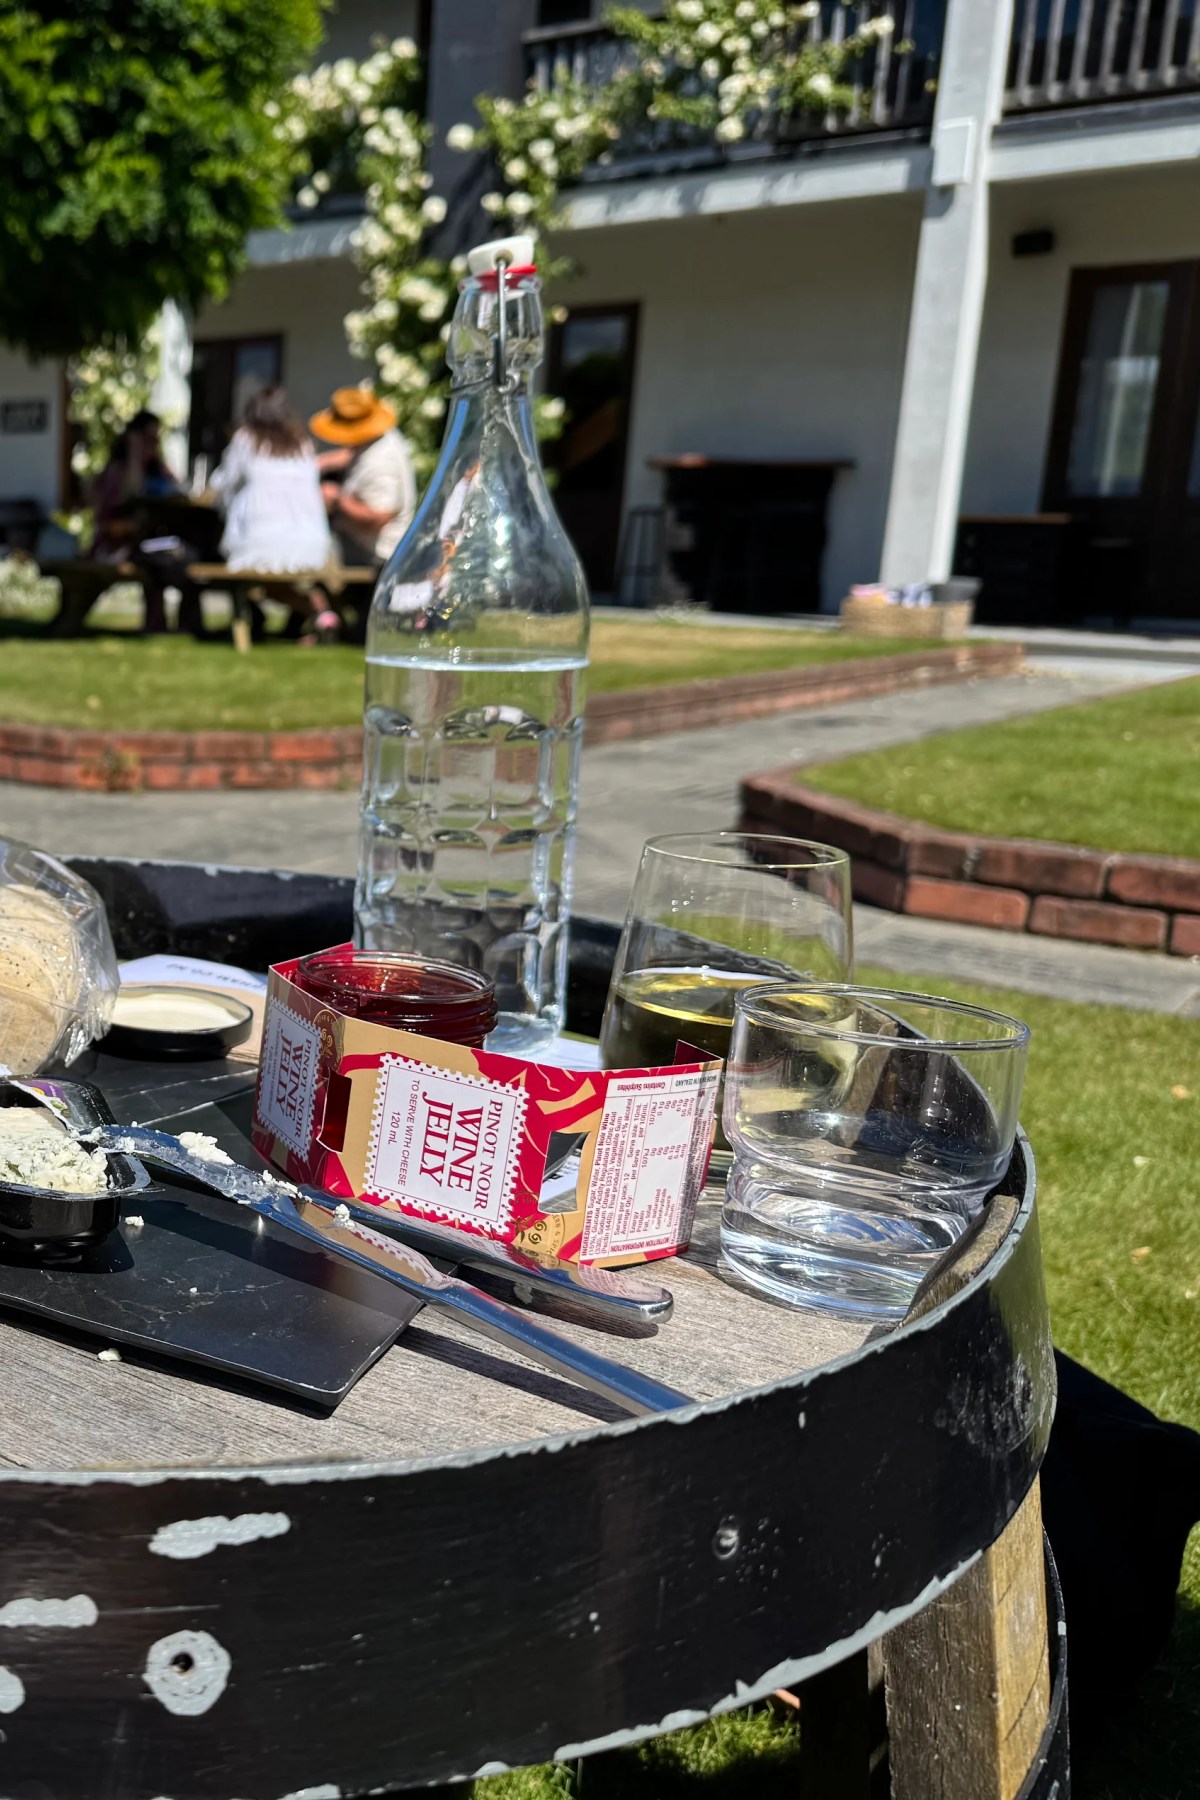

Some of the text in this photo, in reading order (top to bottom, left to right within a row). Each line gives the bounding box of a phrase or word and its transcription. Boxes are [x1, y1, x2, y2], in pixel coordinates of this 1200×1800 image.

[276, 1029, 292, 1117] JELLY
[285, 1042, 303, 1121] WINE
[294, 1038, 312, 1138] PINOT NOIR
[617, 1081, 666, 1091] Contains Sulphites
[614, 1116, 622, 1131] Gum
[623, 1098, 632, 1121] alcohol
[388, 1111, 401, 1145] 120 mL
[398, 1079, 420, 1187] TO SERVE WITH CHEESE
[419, 1091, 453, 1187] JELLY
[620, 1122, 628, 1138] <1%
[447, 1106, 484, 1192] WINE
[474, 1099, 503, 1209] PINOT NOIR
[595, 1183, 604, 1204] Acidity
[600, 1147, 610, 1181] Regulators
[605, 1127, 614, 1145] (Citric
[609, 1133, 619, 1164] Vegetable
[615, 1140, 625, 1166] contains
[581, 1113, 609, 1255] INGREDIENTS Sugar, Water, Pinot Noir Wine
[611, 1168, 620, 1192] product
[629, 1101, 657, 1233] Energy 107kJ 1070kJ
[601, 1187, 610, 1208] Citrate
[614, 1213, 623, 1235] Serves
[627, 1139, 635, 1157] Serve
[620, 1209, 630, 1234] Average
[631, 1149, 640, 1167] Serve
[651, 1188, 661, 1218] saturated
[598, 1210, 606, 1234] Sodium
[636, 1210, 644, 1232] Protein
[610, 1237, 669, 1252] NUTRITION INFORMATION
